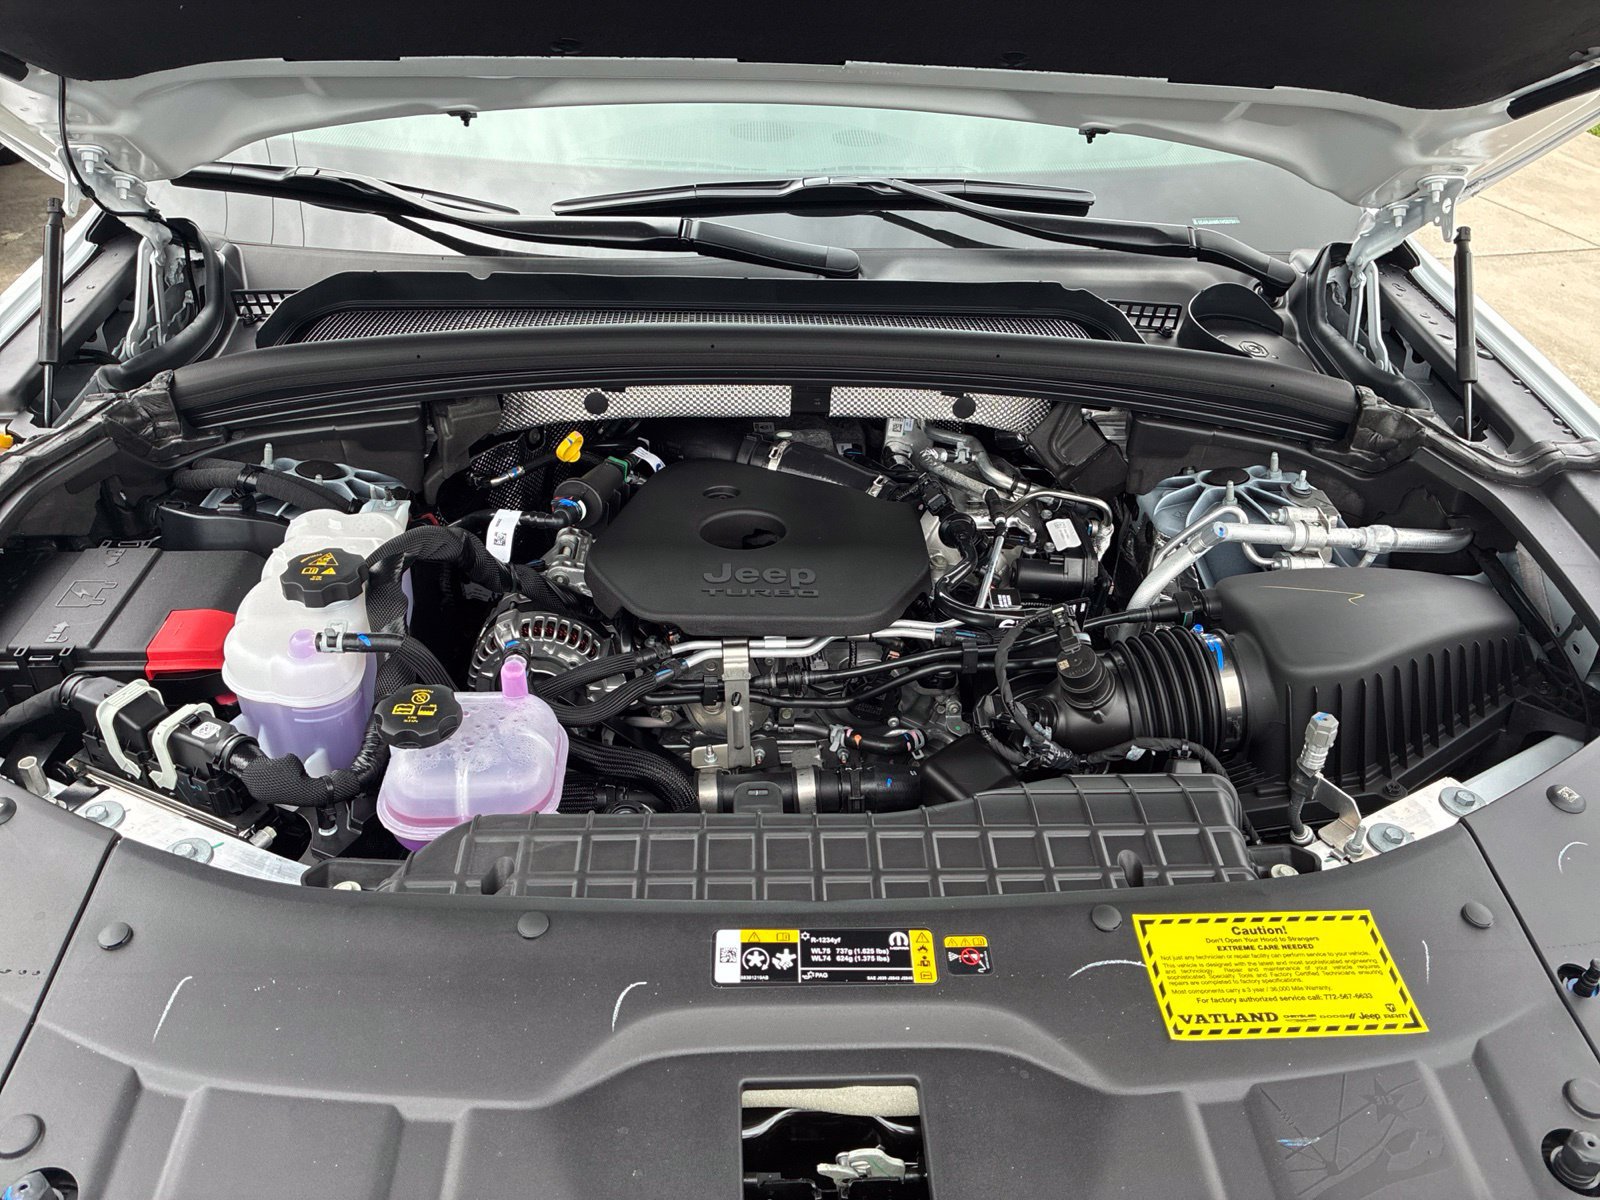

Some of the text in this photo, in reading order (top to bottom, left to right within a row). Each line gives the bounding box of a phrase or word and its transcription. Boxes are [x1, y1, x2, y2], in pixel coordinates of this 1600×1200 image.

[703, 563, 817, 589] Jeep
[701, 588, 819, 598] TURBO
[1231, 925, 1287, 936] Caution!
[810, 937, 842, 945] R-1234yf
[1287, 935, 1320, 943] Strangers
[836, 948, 853, 956] 737g
[875, 947, 890, 956] lbs)
[1216, 944, 1256, 952] EXTREME
[836, 955, 853, 963] 624g
[854, 955, 876, 963] (1.375
[876, 955, 890, 963] lbs)
[1250, 952, 1270, 960] facility
[1282, 951, 1306, 959] perform
[1205, 961, 1233, 969] designed
[1304, 958, 1344, 967] sophisticated
[1344, 957, 1378, 965] engineering
[1262, 965, 1301, 973] maintenance
[1357, 963, 1381, 971] requires
[1209, 973, 1235, 981] Specialty
[1270, 971, 1293, 979] Factory
[1322, 969, 1356, 977] Technicians
[1200, 979, 1232, 987] completed
[1240, 978, 1261, 986] factory
[1187, 988, 1225, 996] components
[1270, 985, 1291, 993] 36,000
[1210, 996, 1237, 1005] factory
[1239, 995, 1279, 1004] authorized
[1279, 994, 1306, 1002] service
[1307, 993, 1323, 1001] call:
[1177, 1012, 1279, 1025] VATLAND
[1358, 1011, 1381, 1021] Jeep
